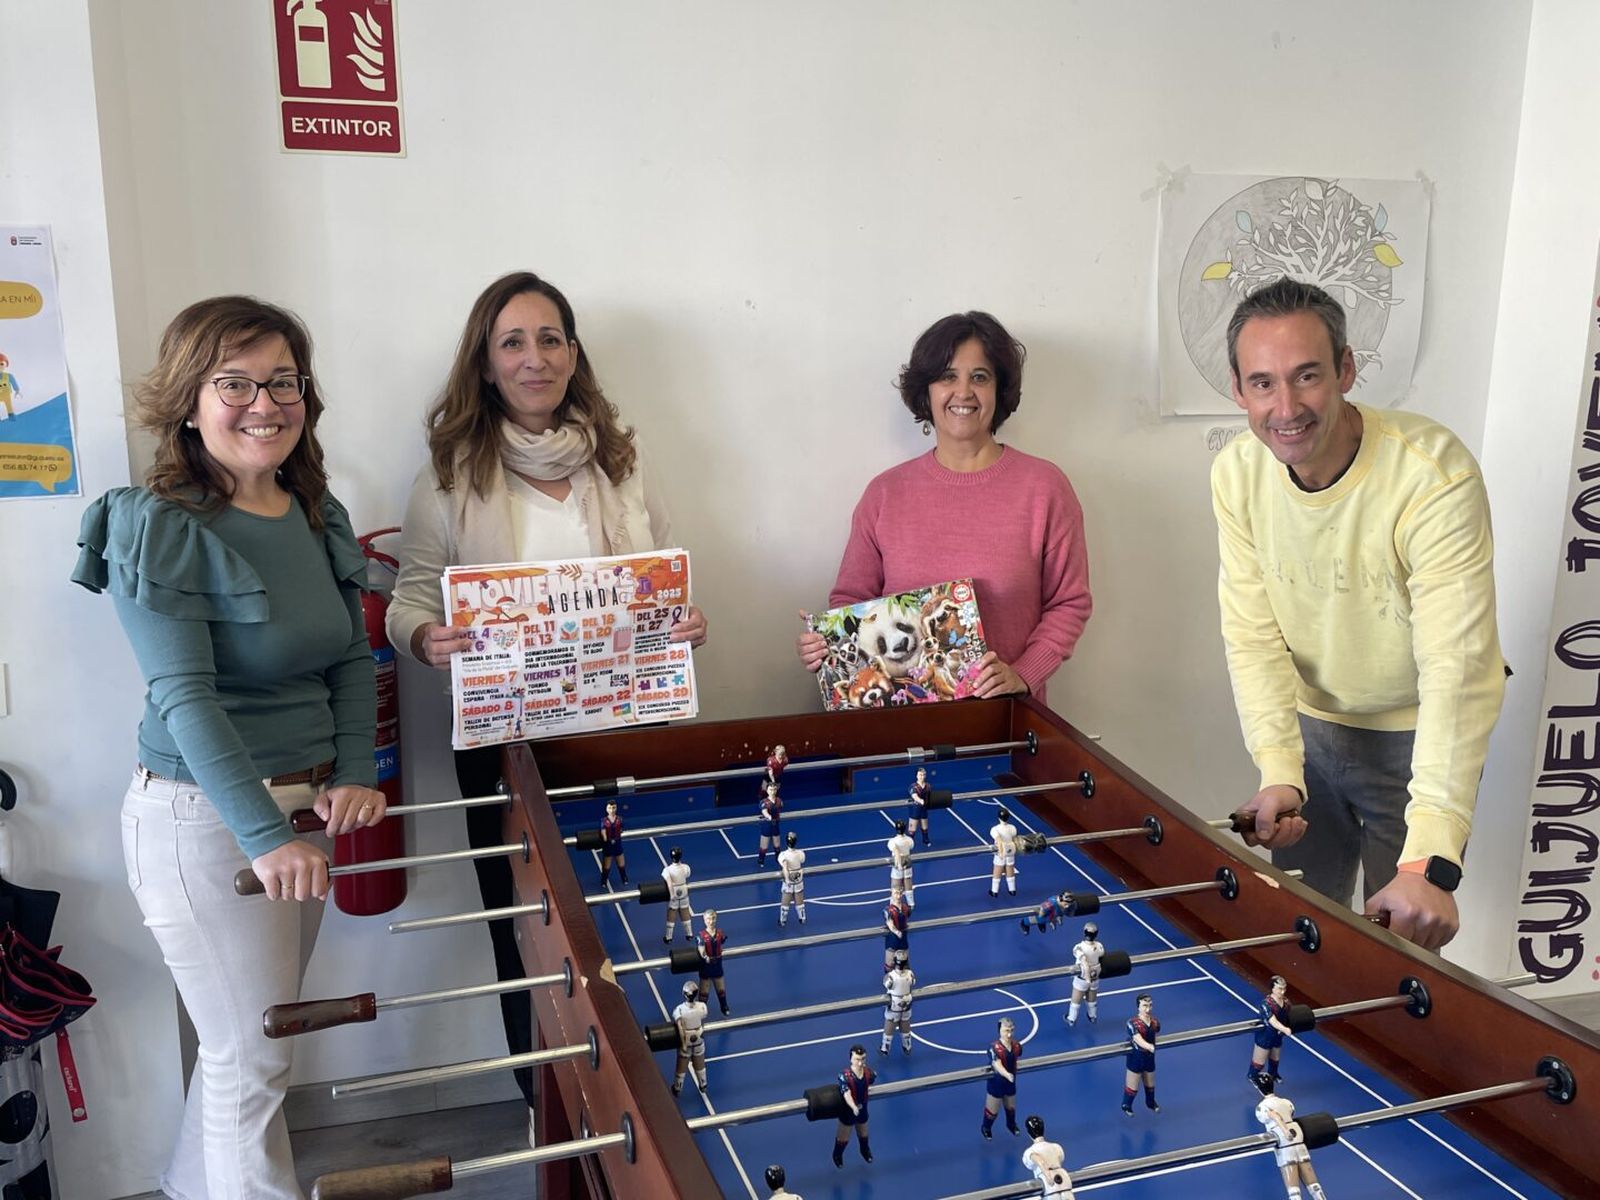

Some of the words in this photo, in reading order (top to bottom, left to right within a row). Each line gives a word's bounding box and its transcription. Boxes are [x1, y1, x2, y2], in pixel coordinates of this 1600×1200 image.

[291, 117, 393, 137] EXTINTOR
[9, 295, 22, 303] EN
[457, 566, 635, 609] NOVIEMBRE
[657, 588, 682, 600] 2025
[548, 586, 619, 615] AGENDA
[636, 611, 651, 621] DEL
[654, 607, 669, 619] 25
[523, 624, 540, 634] DEL
[544, 620, 556, 633] 11
[582, 617, 597, 627] DEL
[636, 623, 645, 633] AL
[648, 620, 663, 631] 27
[481, 628, 490, 639] 4
[524, 638, 535, 647] AL
[539, 633, 553, 645] 13
[475, 641, 485, 652] 6
[462, 655, 484, 663] SEMANA
[581, 657, 614, 671] VIERNES
[617, 654, 629, 665] 21
[634, 652, 667, 666] VIERNES
[669, 649, 686, 661] 28
[462, 673, 506, 687] VIERNES
[508, 671, 517, 683] 7
[523, 668, 561, 682] VIERNES
[564, 665, 577, 676] 14
[463, 688, 500, 697] CONVIVENCIA
[582, 694, 614, 708] SÁBADO
[616, 690, 631, 701] 22
[636, 689, 670, 703] SÁBADO
[462, 703, 501, 717] SÁBADO
[504, 701, 514, 711] 8
[524, 697, 561, 711] SÁBADO
[565, 694, 577, 705] 15
[492, 714, 515, 722] DEFENSA
[464, 723, 492, 731] PERSONAL
[1518, 620, 1600, 984] GUIJUELO
